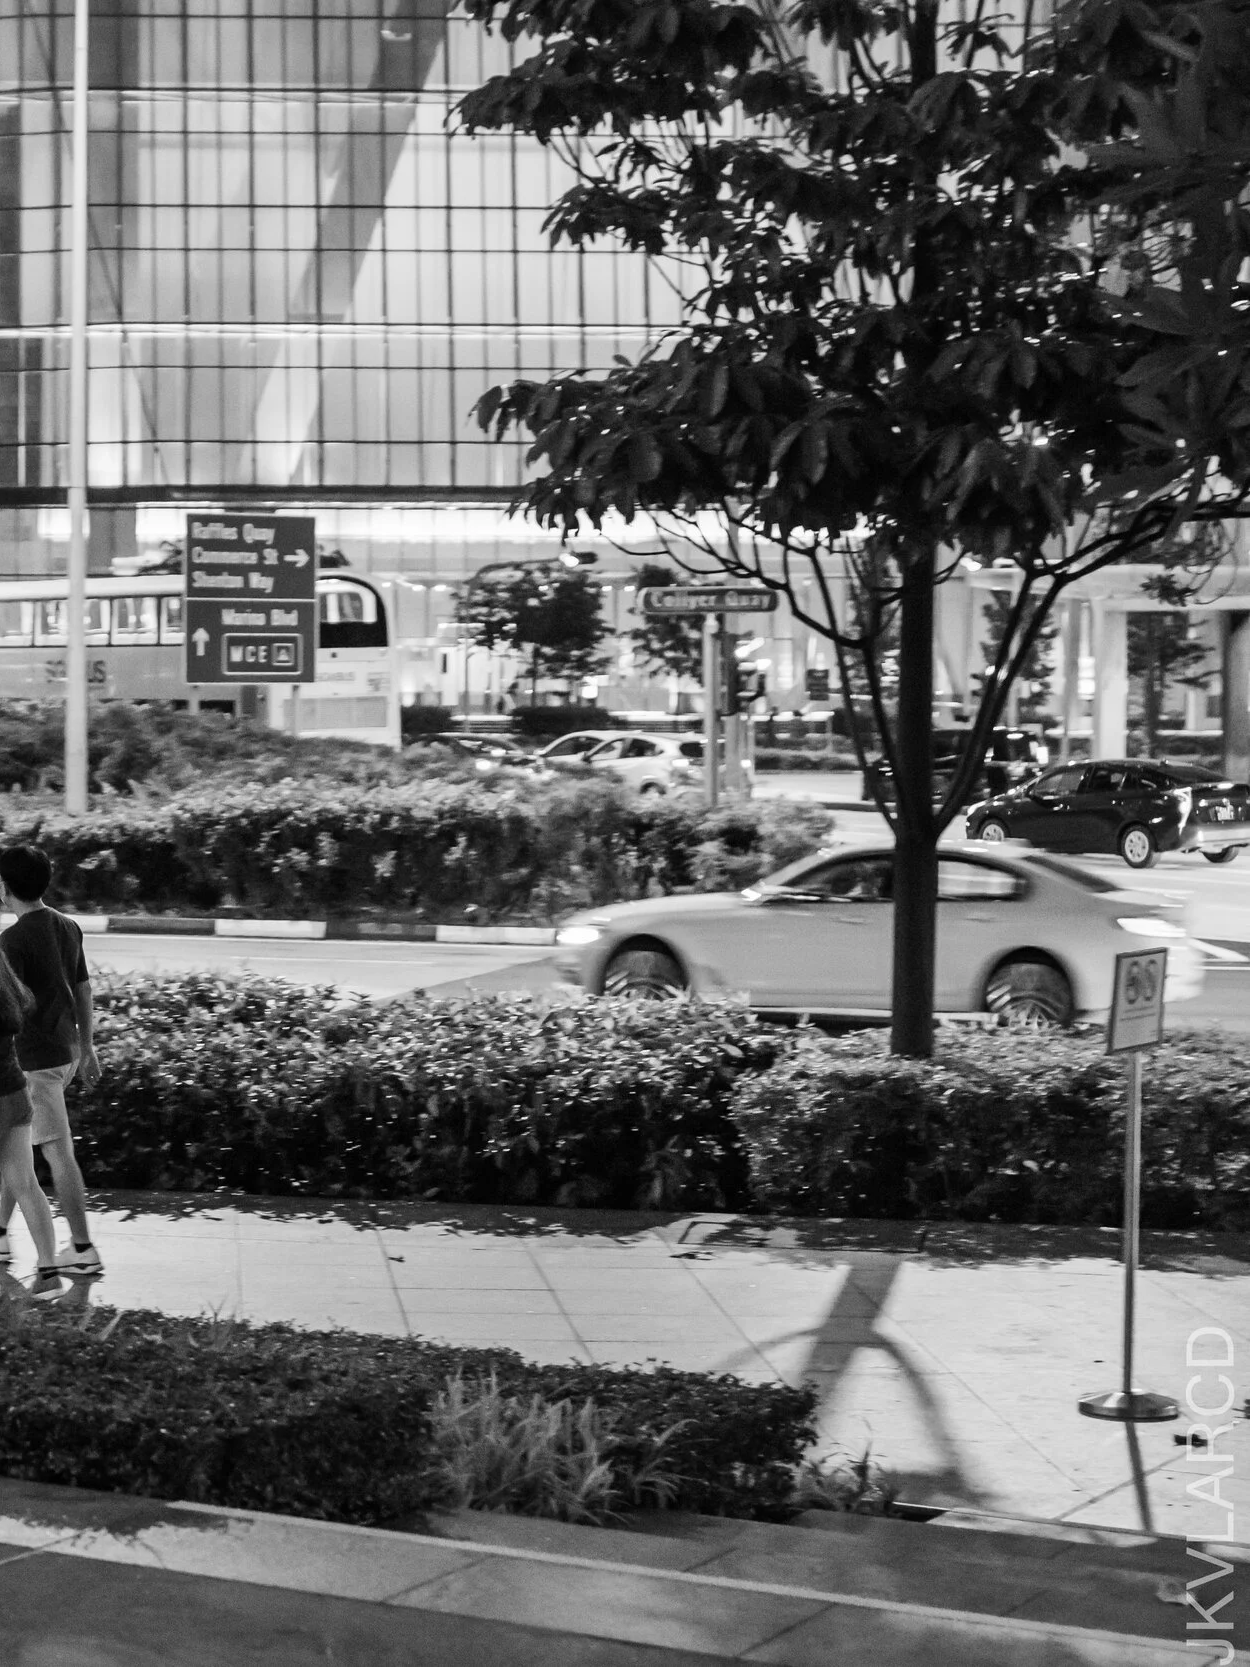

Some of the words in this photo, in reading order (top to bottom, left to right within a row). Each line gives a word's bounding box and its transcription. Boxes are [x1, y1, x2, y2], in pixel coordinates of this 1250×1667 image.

[242, 523, 276, 545] Quay
[650, 589, 717, 610] Collyer
[724, 590, 771, 609] Quay
[230, 645, 268, 663] MCE
